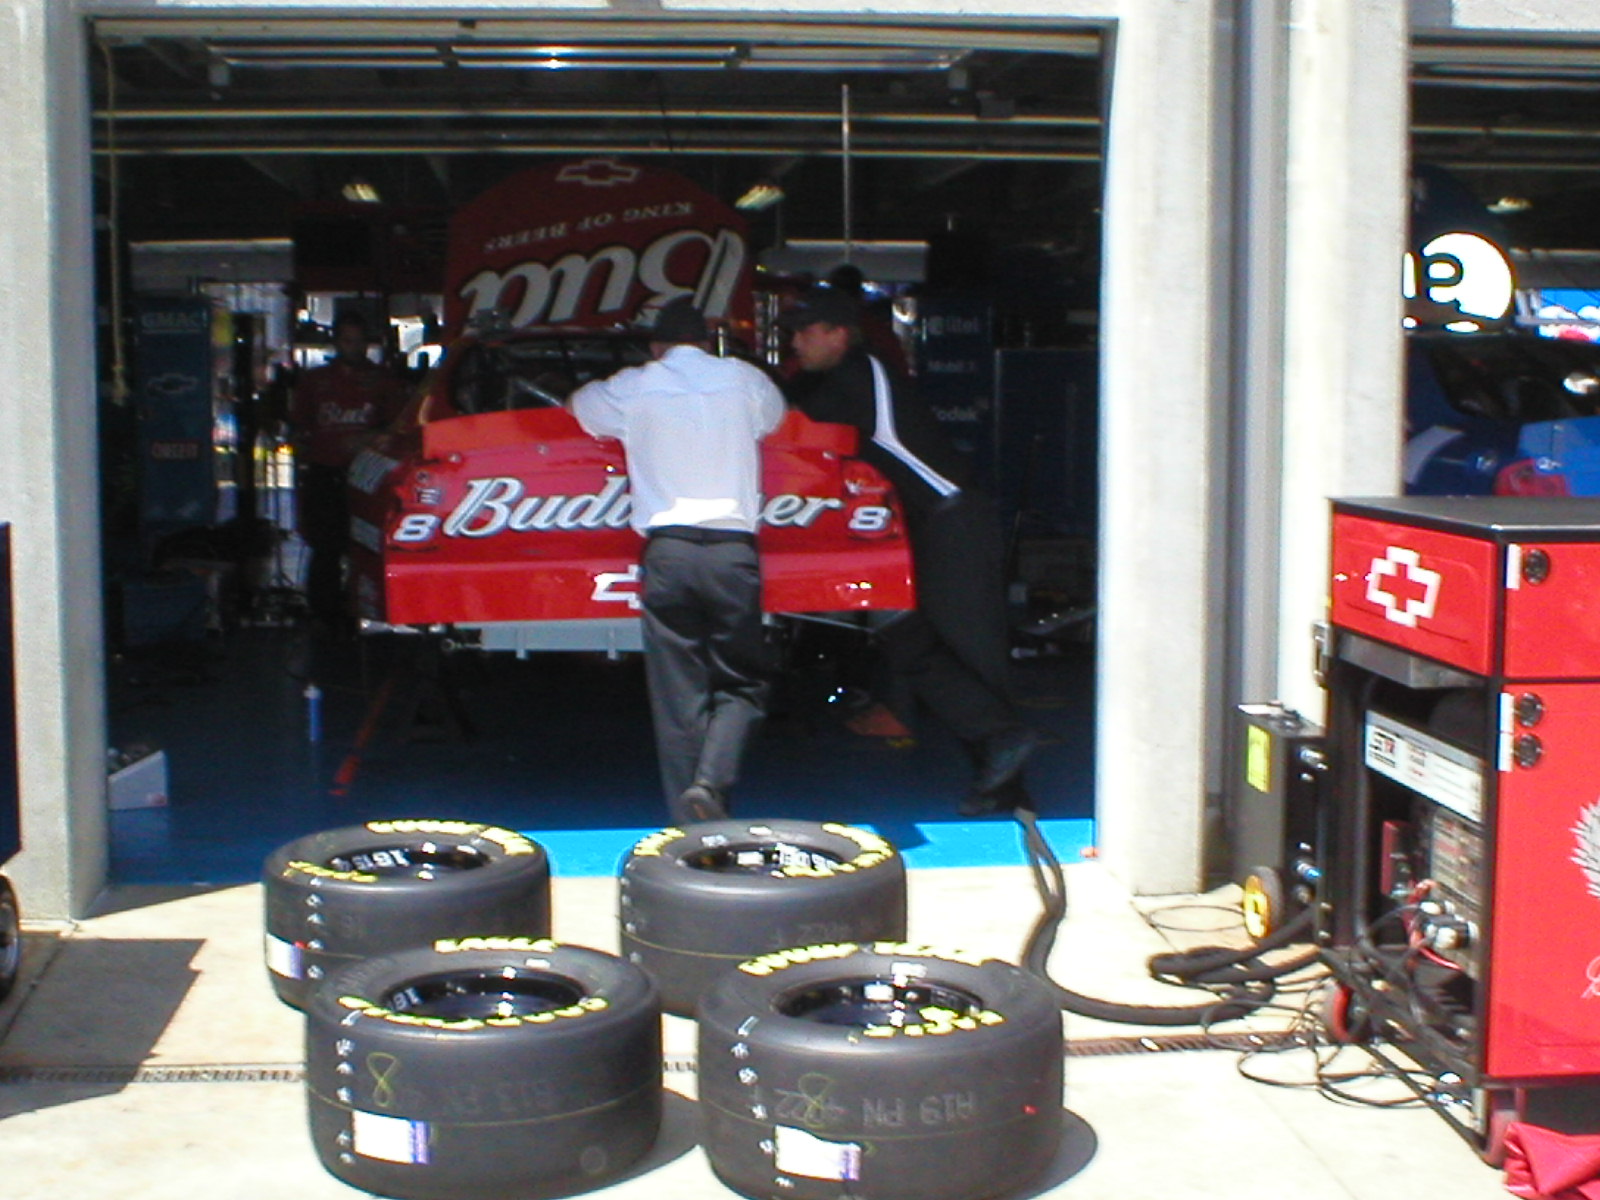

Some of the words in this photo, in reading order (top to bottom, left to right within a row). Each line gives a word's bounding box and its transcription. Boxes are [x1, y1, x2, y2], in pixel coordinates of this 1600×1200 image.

[577, 213, 615, 231] OF
[622, 202, 692, 222] KING
[484, 223, 568, 252] BEERS
[394, 514, 441, 541] 8
[848, 506, 891, 531] 8
